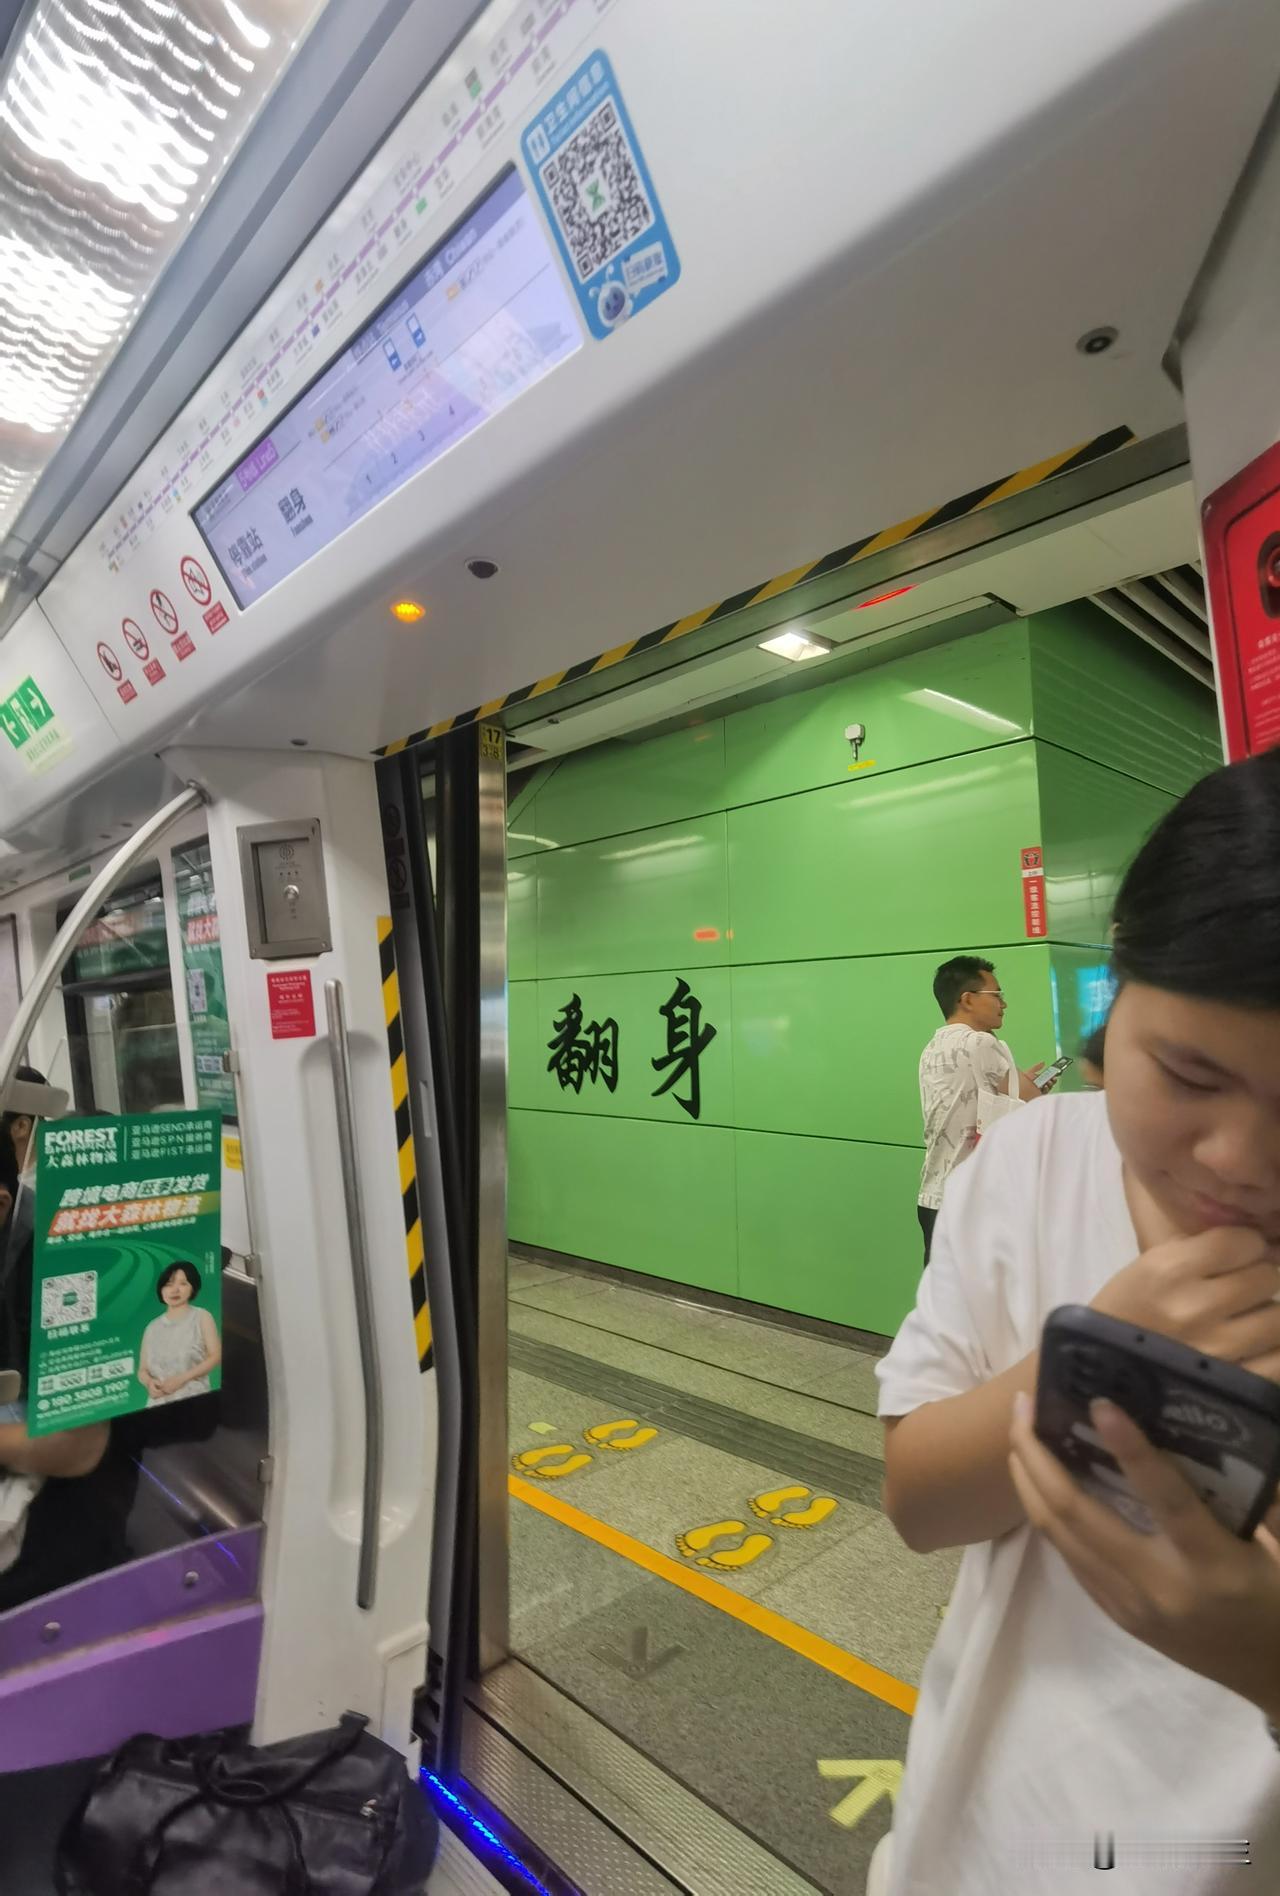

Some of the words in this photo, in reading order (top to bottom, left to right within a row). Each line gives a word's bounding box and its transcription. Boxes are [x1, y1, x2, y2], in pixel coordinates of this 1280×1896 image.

[486, 728, 501, 744] 17
[547, 977, 717, 1120] 翻身
[45, 1127, 118, 1147] FOREST
[46, 1151, 118, 1168] 大森林物流
